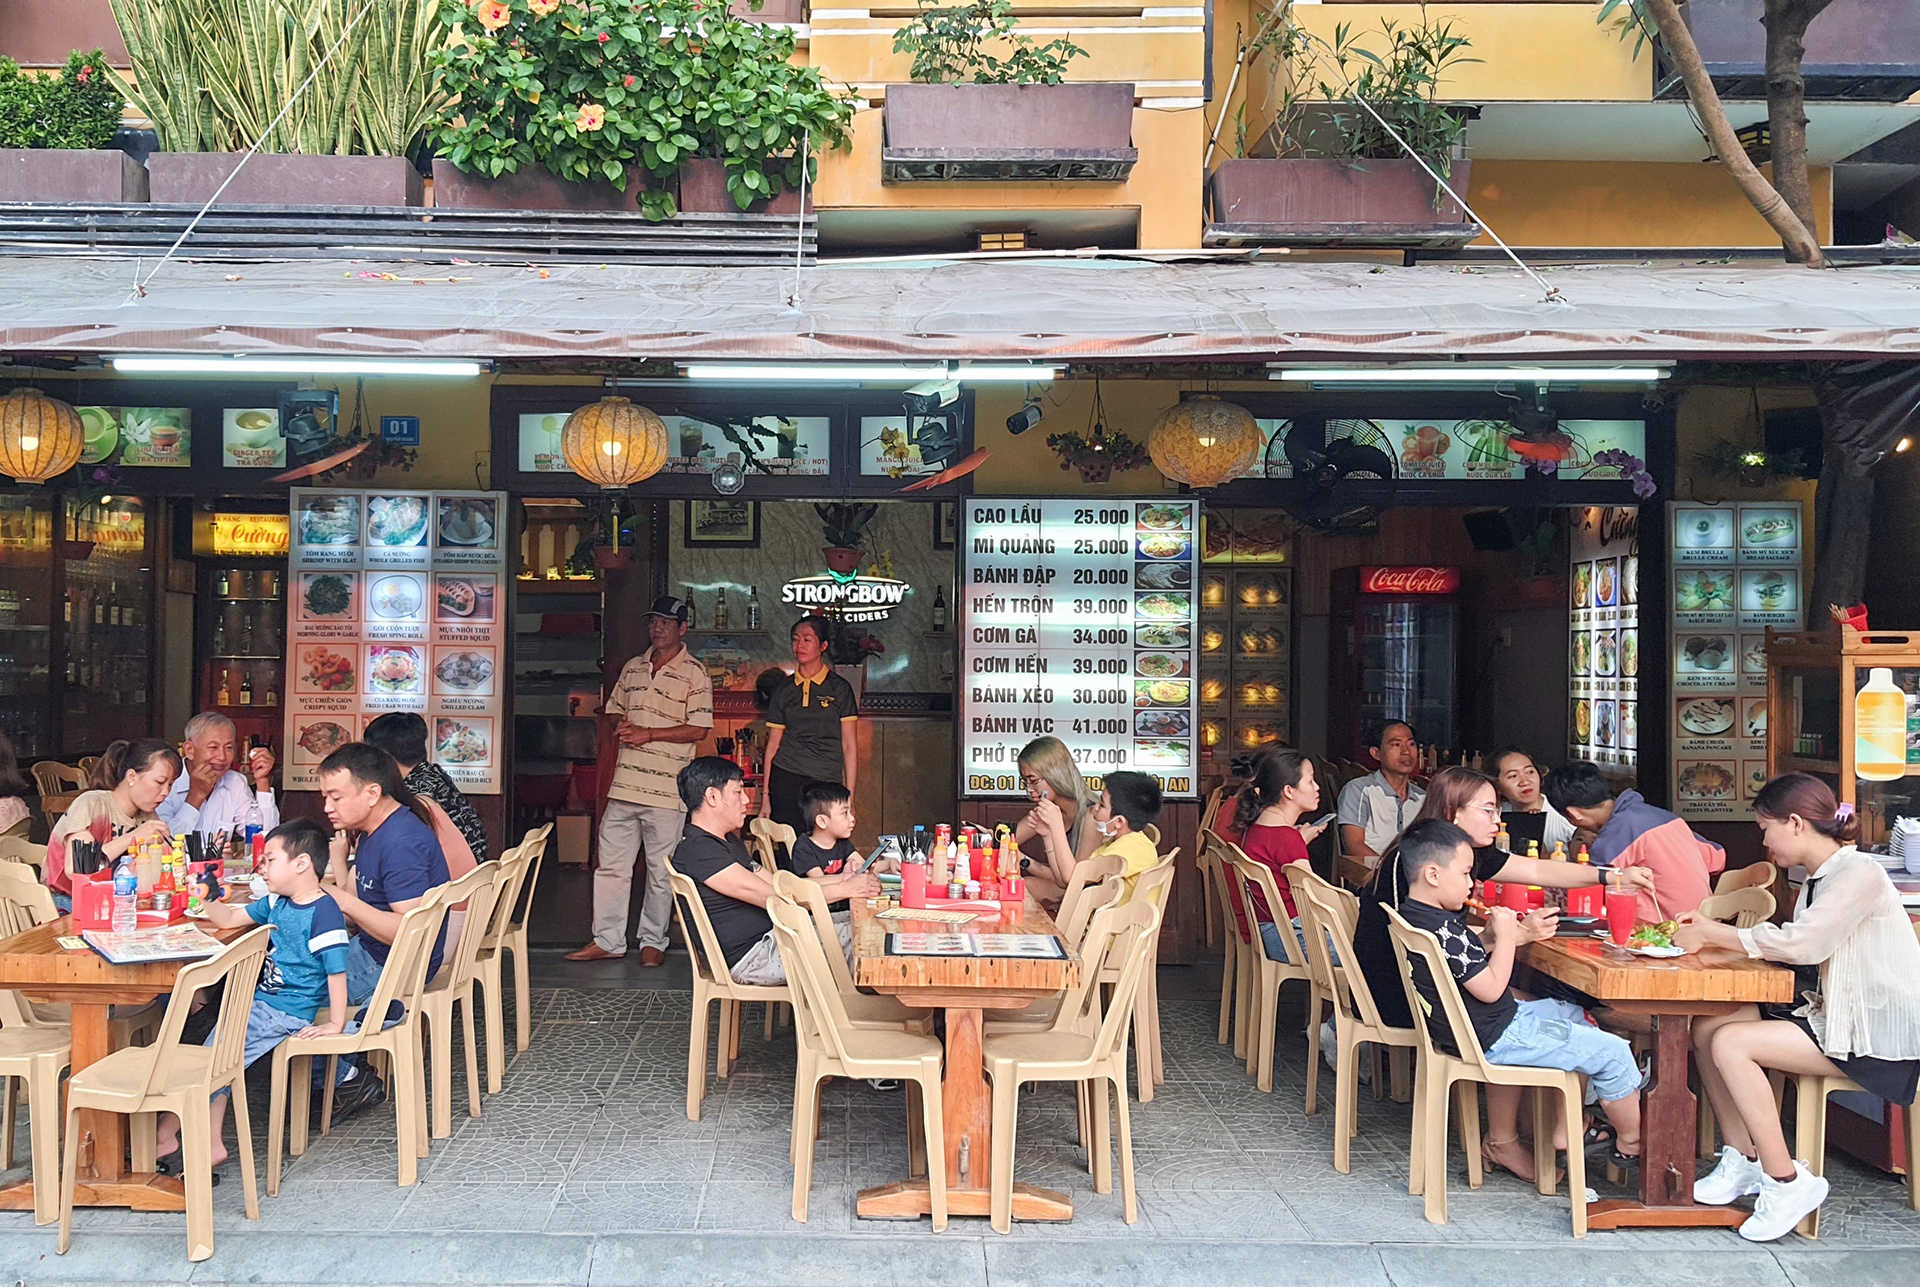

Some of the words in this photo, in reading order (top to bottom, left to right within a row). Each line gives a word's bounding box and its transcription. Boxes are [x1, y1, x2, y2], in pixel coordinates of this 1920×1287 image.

[390, 420, 408, 434] 01
[974, 508, 1006, 524] CAO
[1012, 503, 1042, 524] LẦU
[1074, 509, 1129, 524] 25.000
[974, 536, 994, 554] MÌ
[1000, 533, 1055, 556] QUẢNG
[1074, 539, 1128, 554] 25.000
[974, 566, 1018, 583] BÁNH
[1023, 566, 1056, 587] ĐẬP
[1074, 568, 1128, 584] 20.000
[1369, 567, 1448, 592] Coca-Cola
[781, 583, 909, 603] STRONGBOW
[973, 593, 1006, 613] HẾN
[1010, 596, 1054, 616] TRỘN
[1074, 599, 1128, 614] 39.000
[844, 610, 889, 622] CIDERS
[973, 626, 1012, 643] CƠM
[1015, 624, 1037, 643] GÀ
[1073, 628, 1128, 644] 34.000
[973, 656, 1009, 673] CƠM
[1015, 653, 1047, 673] HẾN
[1073, 658, 1128, 674] 39.000
[972, 685, 1017, 703] BÁNH
[1073, 689, 1127, 704] 30.000
[972, 714, 1017, 732] BÁNH
[1023, 718, 1054, 736] VẠC
[1073, 719, 1127, 734] 41.000
[972, 742, 1005, 763] PHỞ
[1074, 749, 1127, 764] 37.000
[970, 775, 994, 790] ĐC:
[997, 776, 1014, 790] 01
[1168, 778, 1189, 792] AN
